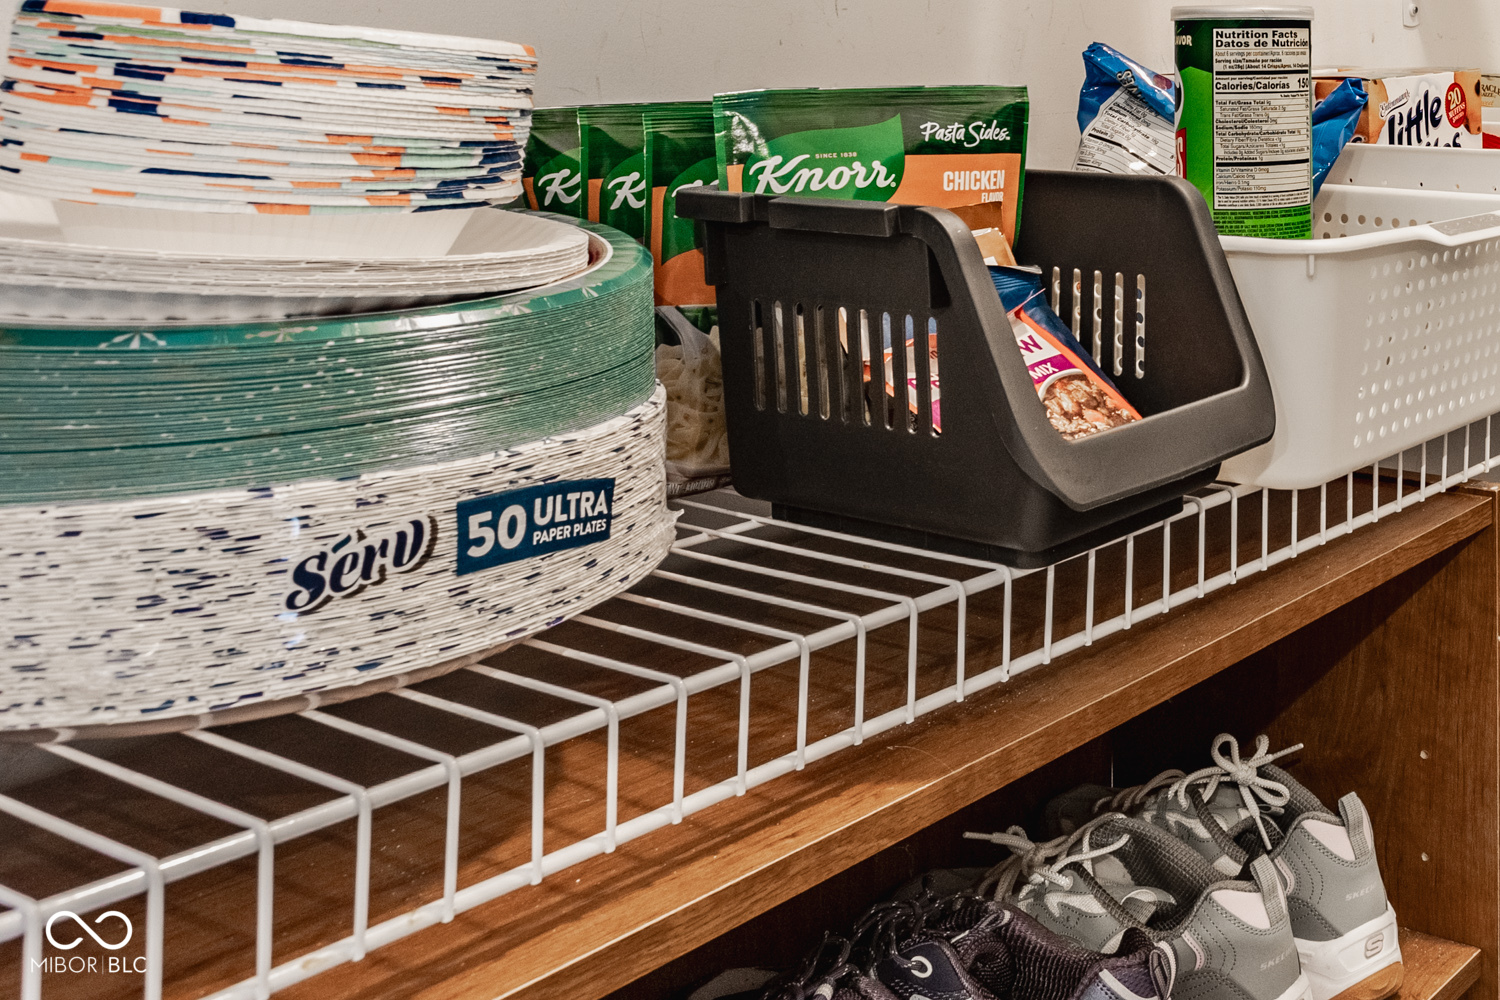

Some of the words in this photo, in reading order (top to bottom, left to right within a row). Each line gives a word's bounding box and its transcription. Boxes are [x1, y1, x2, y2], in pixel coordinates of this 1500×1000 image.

[1215, 30, 1269, 39] Nutrition
[1272, 30, 1298, 39] Facts
[1215, 39, 1250, 48] Datos
[1253, 39, 1268, 47] de
[1215, 81, 1290, 91] Calories/Calorías
[1447, 87, 1462, 110] 20
[920, 121, 965, 143] Pasta
[814, 152, 838, 160] SINCE
[748, 154, 897, 195] Knorr
[943, 169, 1005, 192] CHICKEN
[981, 192, 1004, 203] FLAVOR
[1029, 361, 1059, 380] MIX
[466, 505, 527, 559] 50
[533, 490, 608, 526] ULTRA
[532, 525, 571, 546] PAPER
[572, 519, 608, 538] PLATES
